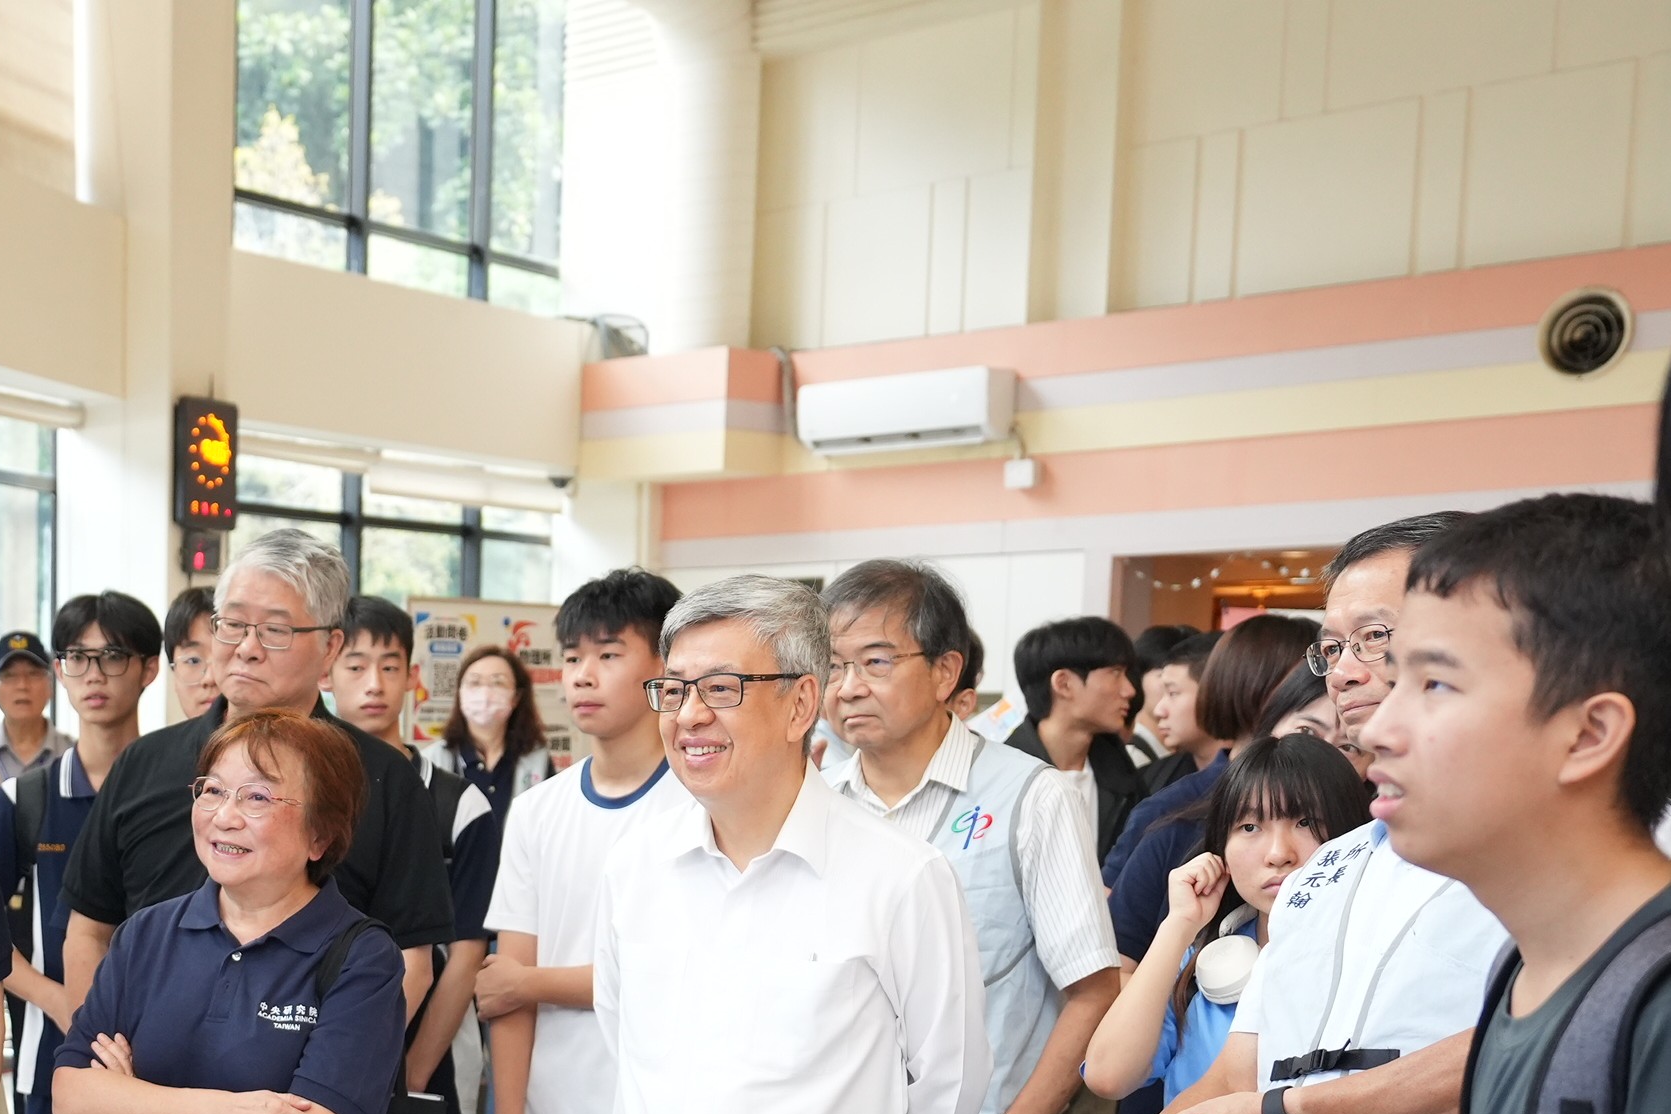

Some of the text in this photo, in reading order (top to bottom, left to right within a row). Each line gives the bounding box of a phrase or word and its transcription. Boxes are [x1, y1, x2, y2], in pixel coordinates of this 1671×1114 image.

[1286, 848, 1343, 908] 張元翰
[259, 1001, 318, 1017] 中央研究院
[257, 1010, 317, 1024] ACADEMIA SINICA
[273, 1022, 301, 1031] TAIWAN
